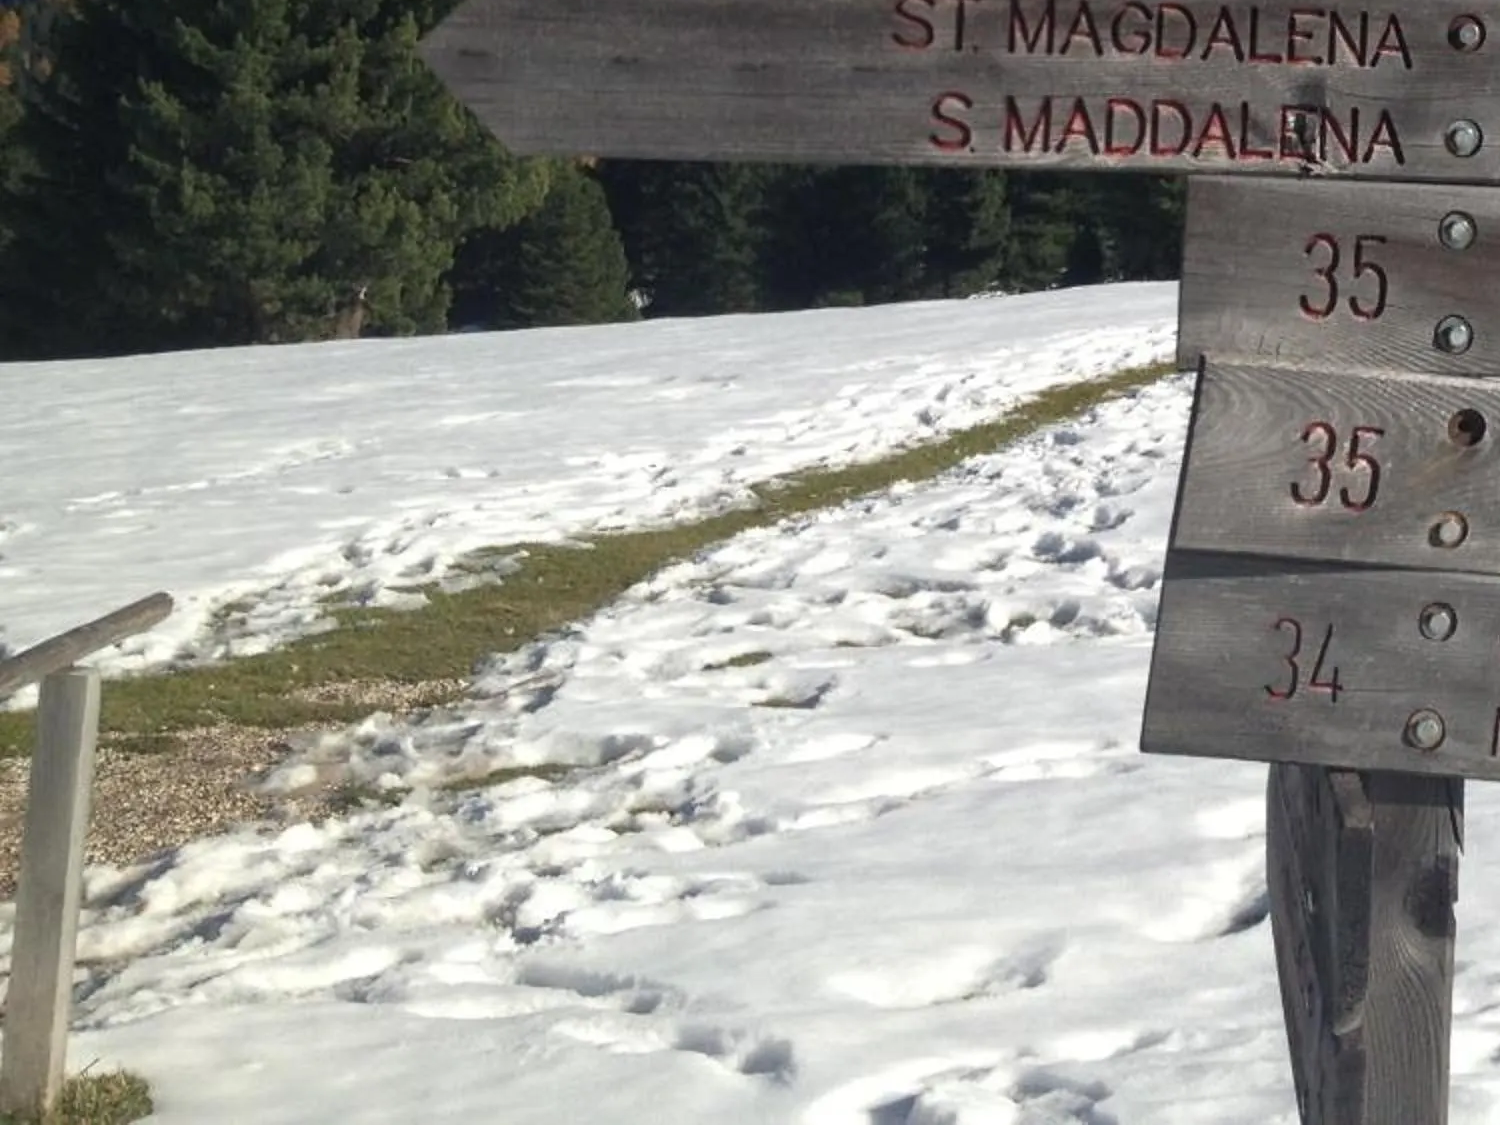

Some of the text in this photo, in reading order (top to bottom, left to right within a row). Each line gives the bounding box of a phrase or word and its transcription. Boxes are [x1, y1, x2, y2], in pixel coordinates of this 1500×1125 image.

[928, 92, 1406, 165] S. MADDALENA
[1299, 232, 1389, 323] 35
[1290, 420, 1386, 512] 35
[1265, 616, 1345, 706] 34
